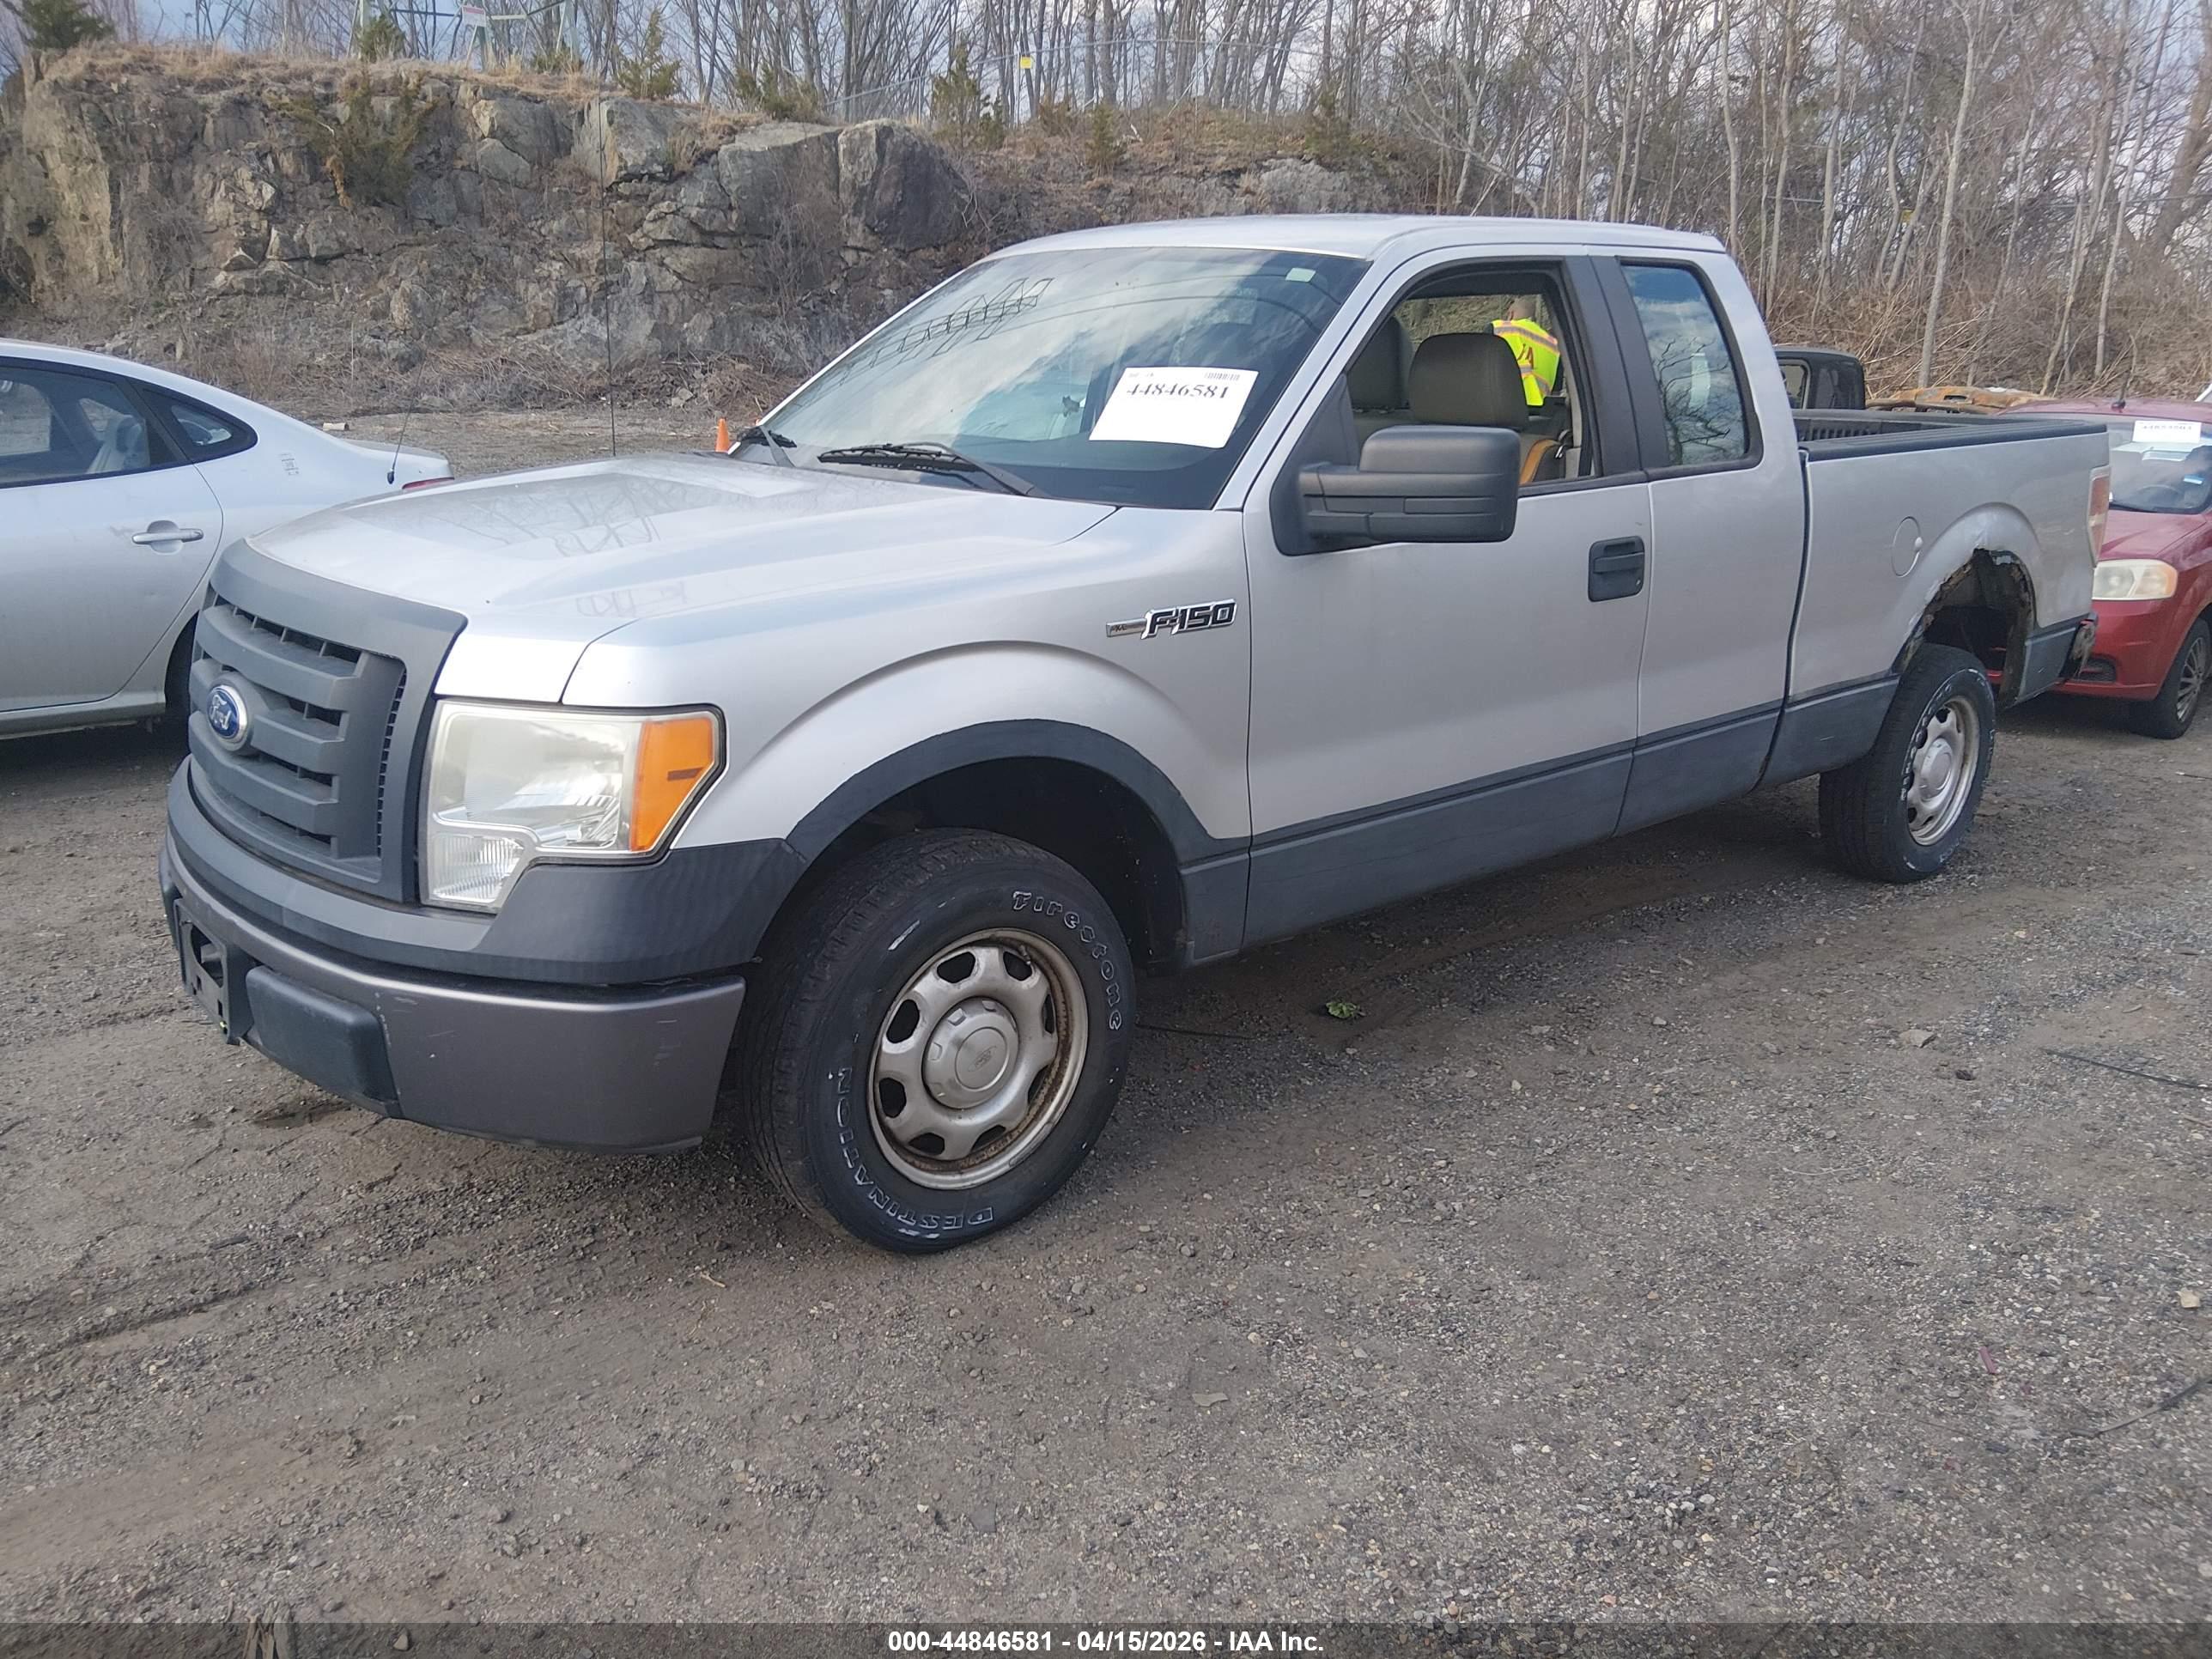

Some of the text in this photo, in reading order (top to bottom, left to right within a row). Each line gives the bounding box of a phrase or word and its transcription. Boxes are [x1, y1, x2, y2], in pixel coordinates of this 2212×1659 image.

[1126, 383, 1230, 399] 44846581
[1140, 599, 1237, 640] F-150
[208, 692, 234, 731] Ford
[1012, 890, 1122, 1030] Firestone
[836, 1067, 994, 1230] DESTINATION
